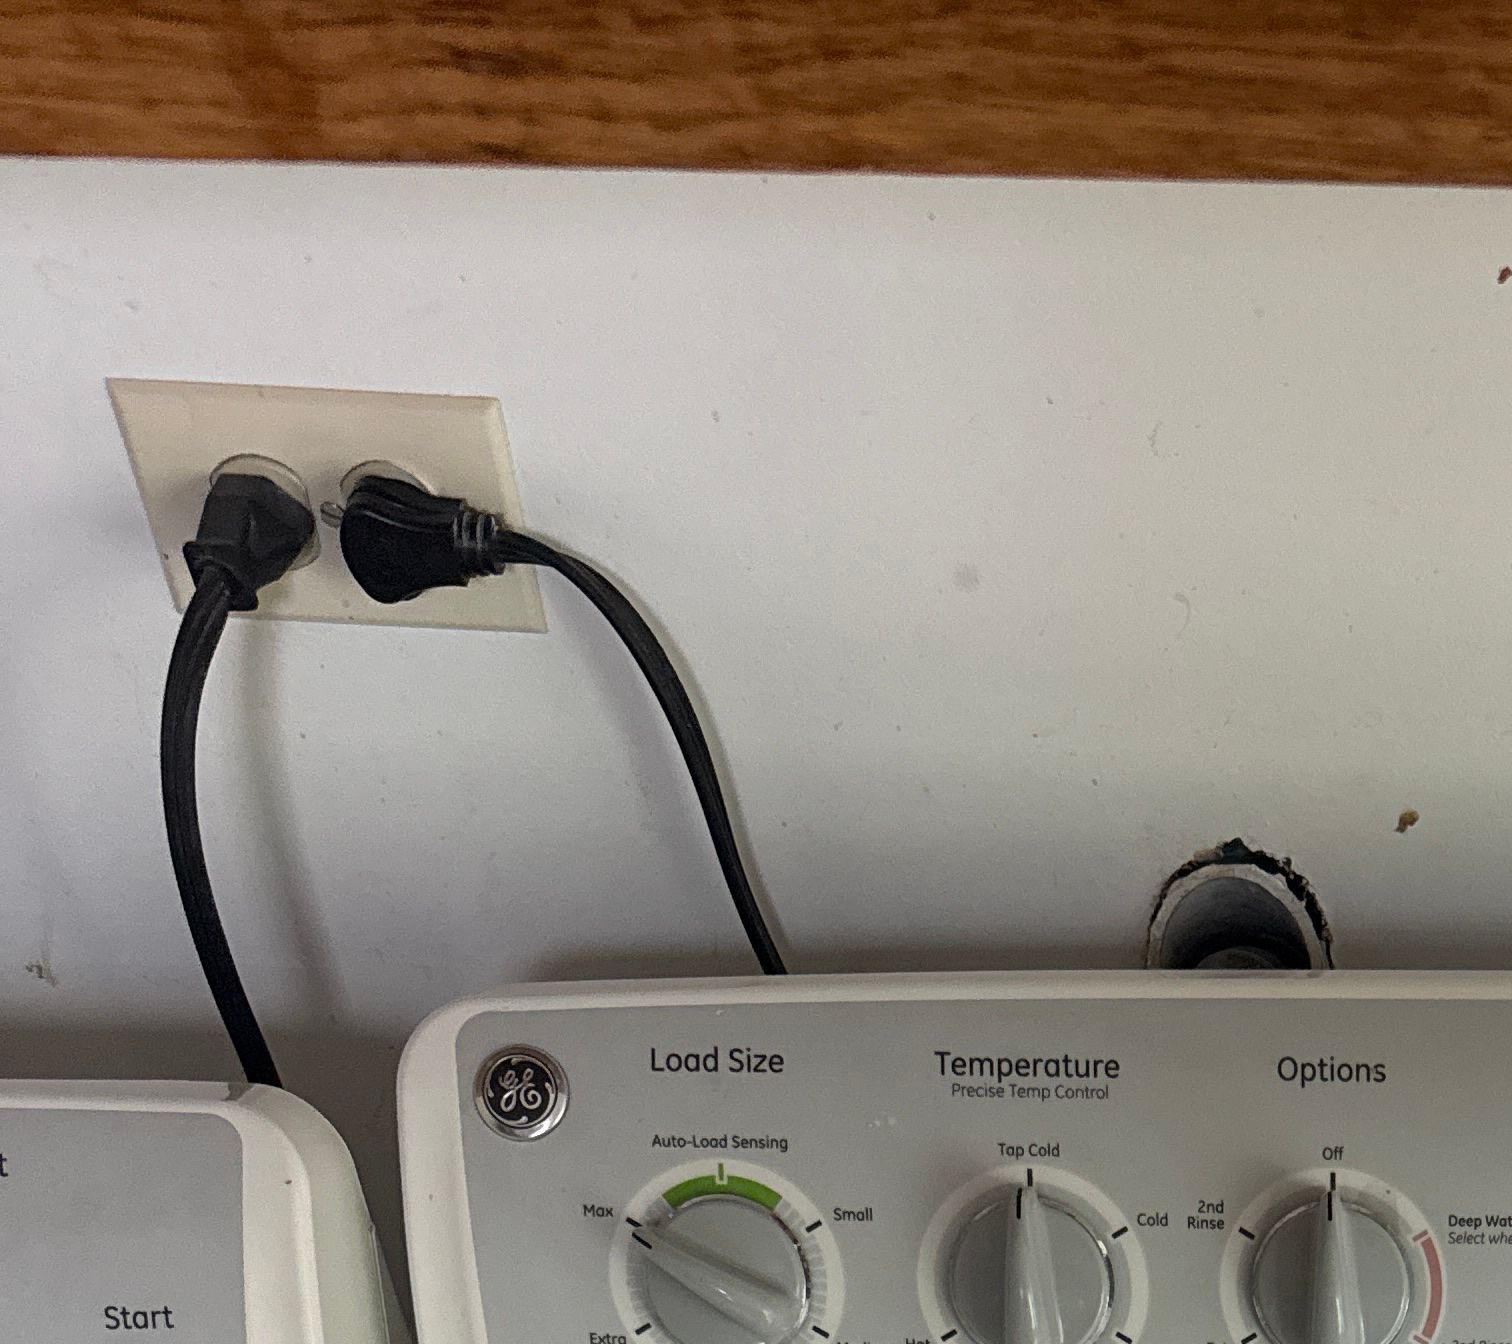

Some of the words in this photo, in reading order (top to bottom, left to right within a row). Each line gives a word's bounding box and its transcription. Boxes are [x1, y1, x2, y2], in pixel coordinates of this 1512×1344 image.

[651, 1046, 718, 1072] Load
[729, 1048, 784, 1073] Size
[935, 1051, 1119, 1083] Temperature
[1278, 1056, 1386, 1088] Options
[499, 1071, 542, 1113] GE
[952, 1083, 1004, 1098] Precise
[1009, 1084, 1050, 1102] Temp
[1055, 1085, 1108, 1099] Control
[652, 1135, 727, 1148] Auto-Load
[732, 1135, 788, 1152] Sensing
[998, 1143, 1024, 1160] Tap
[1029, 1143, 1059, 1157] Cold
[1322, 1146, 1344, 1160] Off
[583, 1205, 613, 1217] Max
[834, 1207, 872, 1221] Small
[1198, 1200, 1224, 1214] 2nd
[1137, 1213, 1168, 1226] Cold
[1188, 1216, 1224, 1230] Rinse
[1449, 1215, 1482, 1230] Deep
[1448, 1231, 1485, 1244] Select
[104, 1306, 174, 1329] Start
[590, 1333, 626, 1344] Extra
